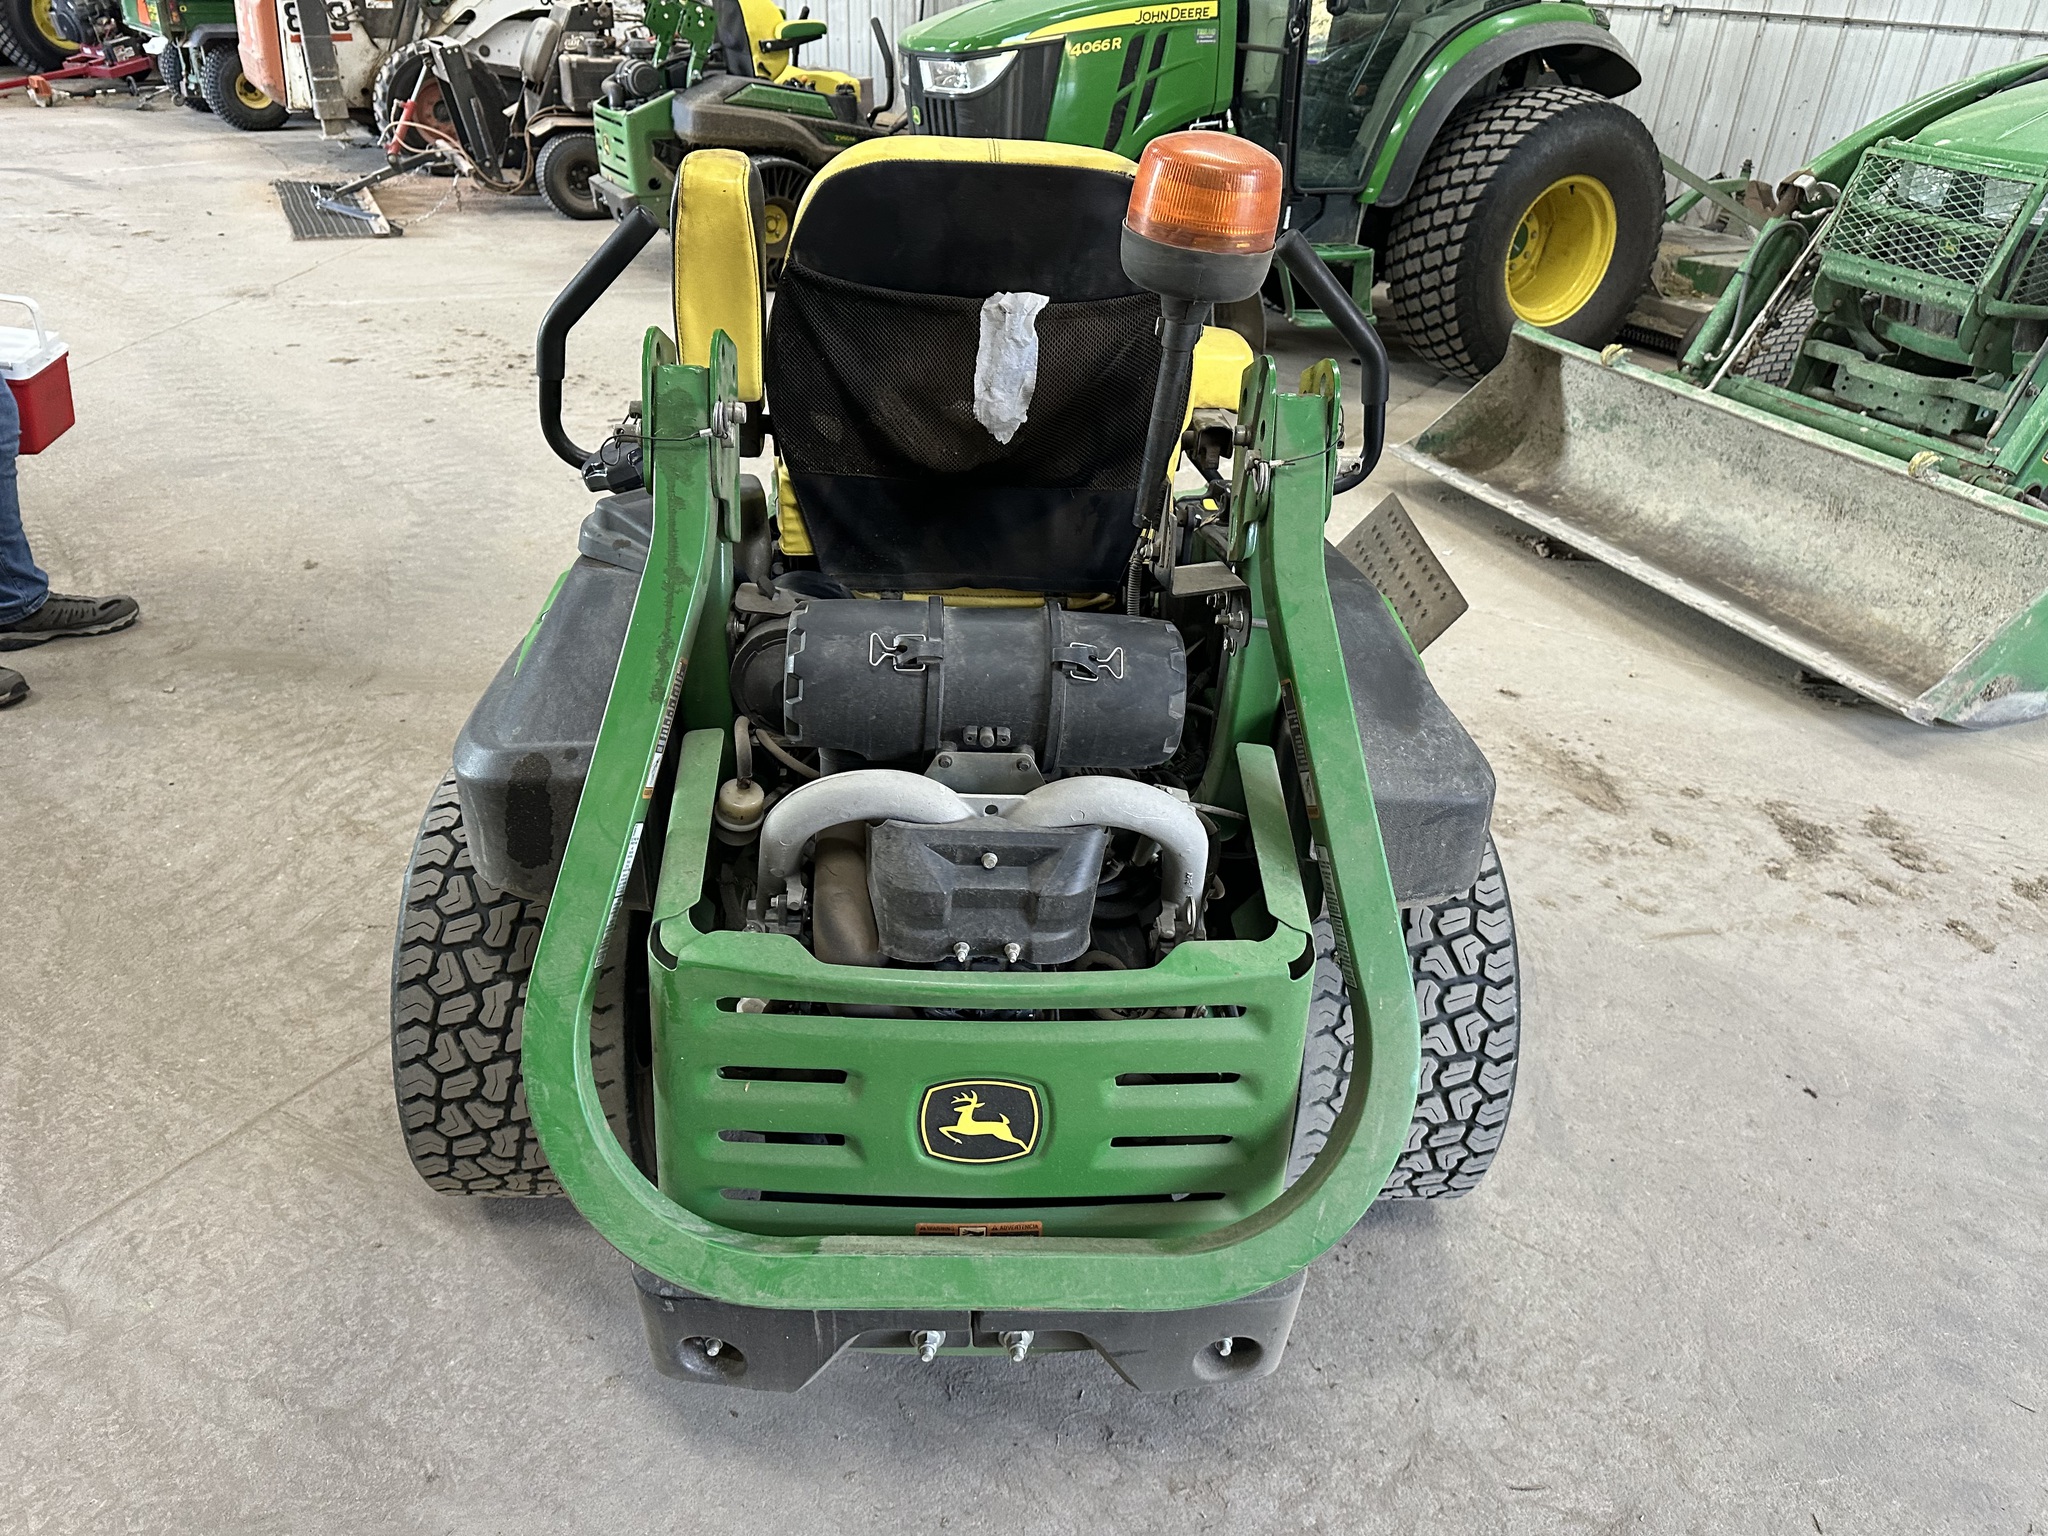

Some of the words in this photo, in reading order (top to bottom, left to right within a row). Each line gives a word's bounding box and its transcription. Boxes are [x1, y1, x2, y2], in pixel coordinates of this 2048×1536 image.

[1135, 9, 1169, 23] JOHN
[1170, 7, 1210, 20] DEERE
[1070, 37, 1122, 56] 4066R
